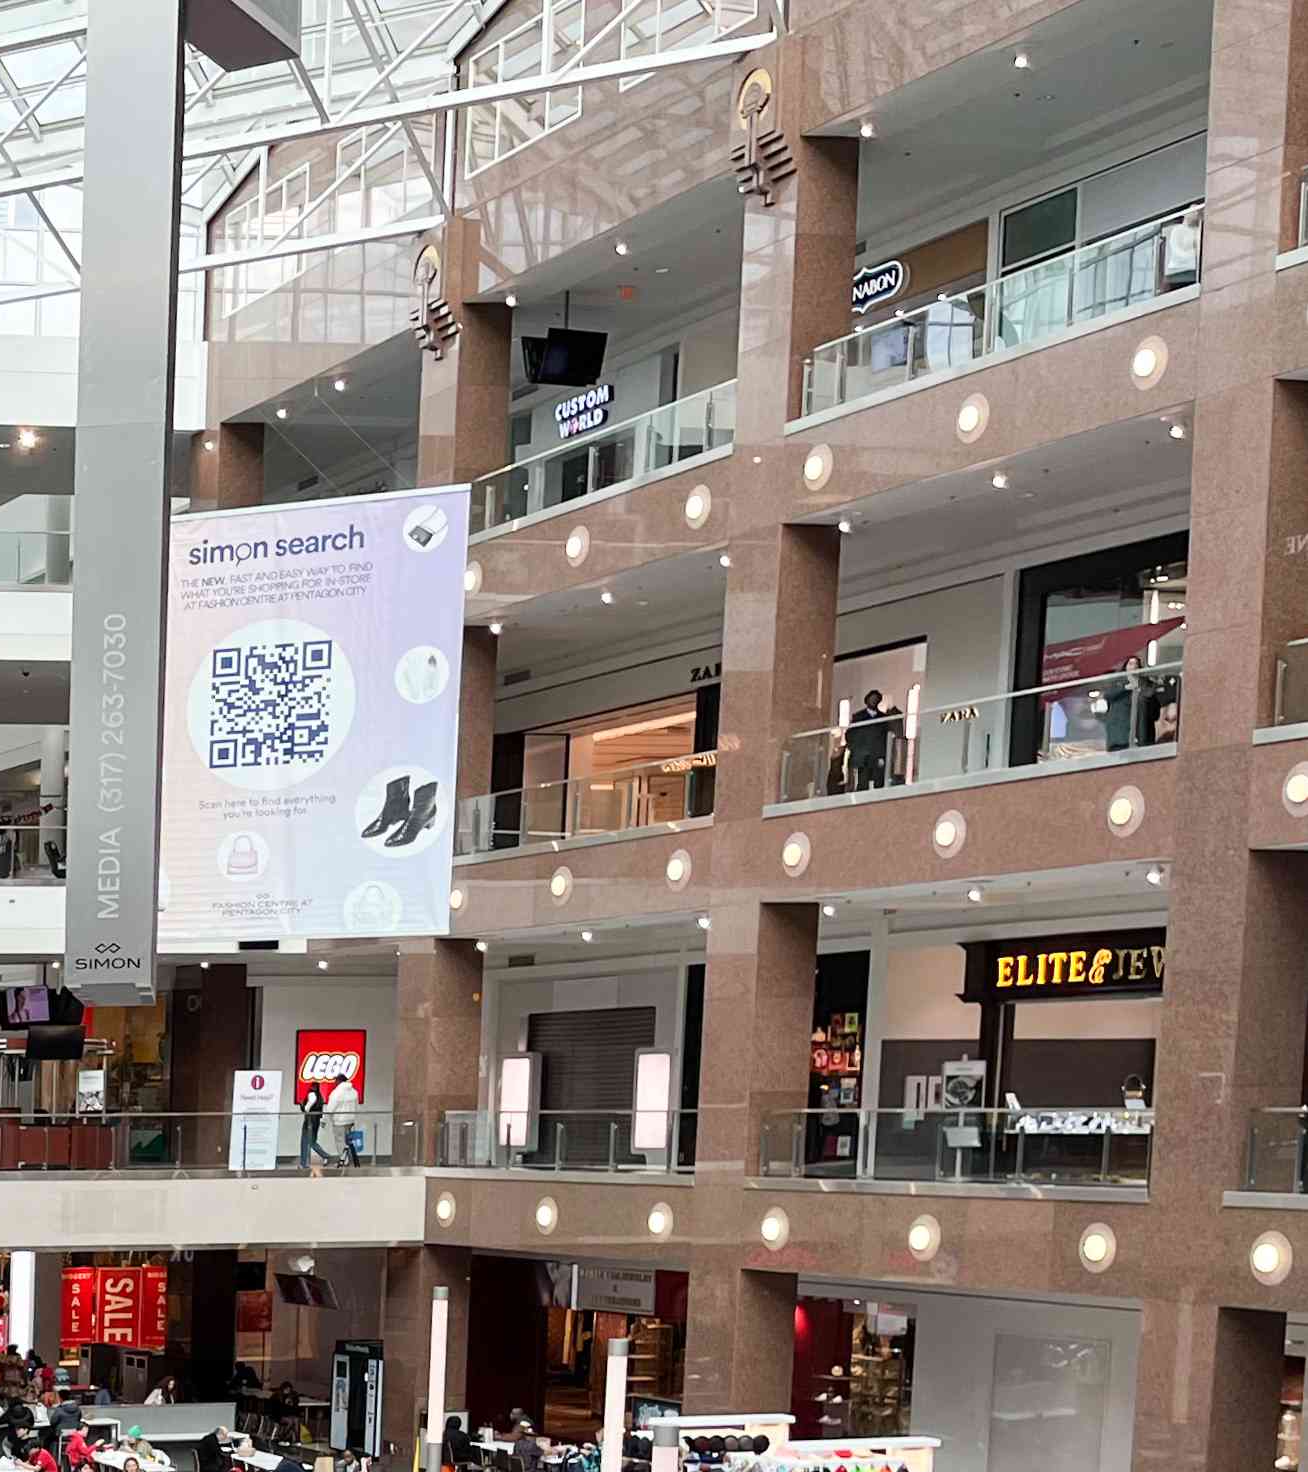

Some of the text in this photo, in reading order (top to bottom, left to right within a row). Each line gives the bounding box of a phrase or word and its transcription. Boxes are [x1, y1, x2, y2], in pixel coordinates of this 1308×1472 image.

[554, 385, 609, 421] CUSTOM
[189, 524, 365, 567] simon search
[97, 613, 127, 919] MEDIA (317) 263-7030
[75, 957, 141, 970] SIMON
[996, 951, 1087, 988] ELITE
[302, 1053, 358, 1081] LEGO
[71, 1283, 81, 1333] SALE
[104, 1278, 134, 1343] SALE
[156, 1282, 167, 1331] SALE
